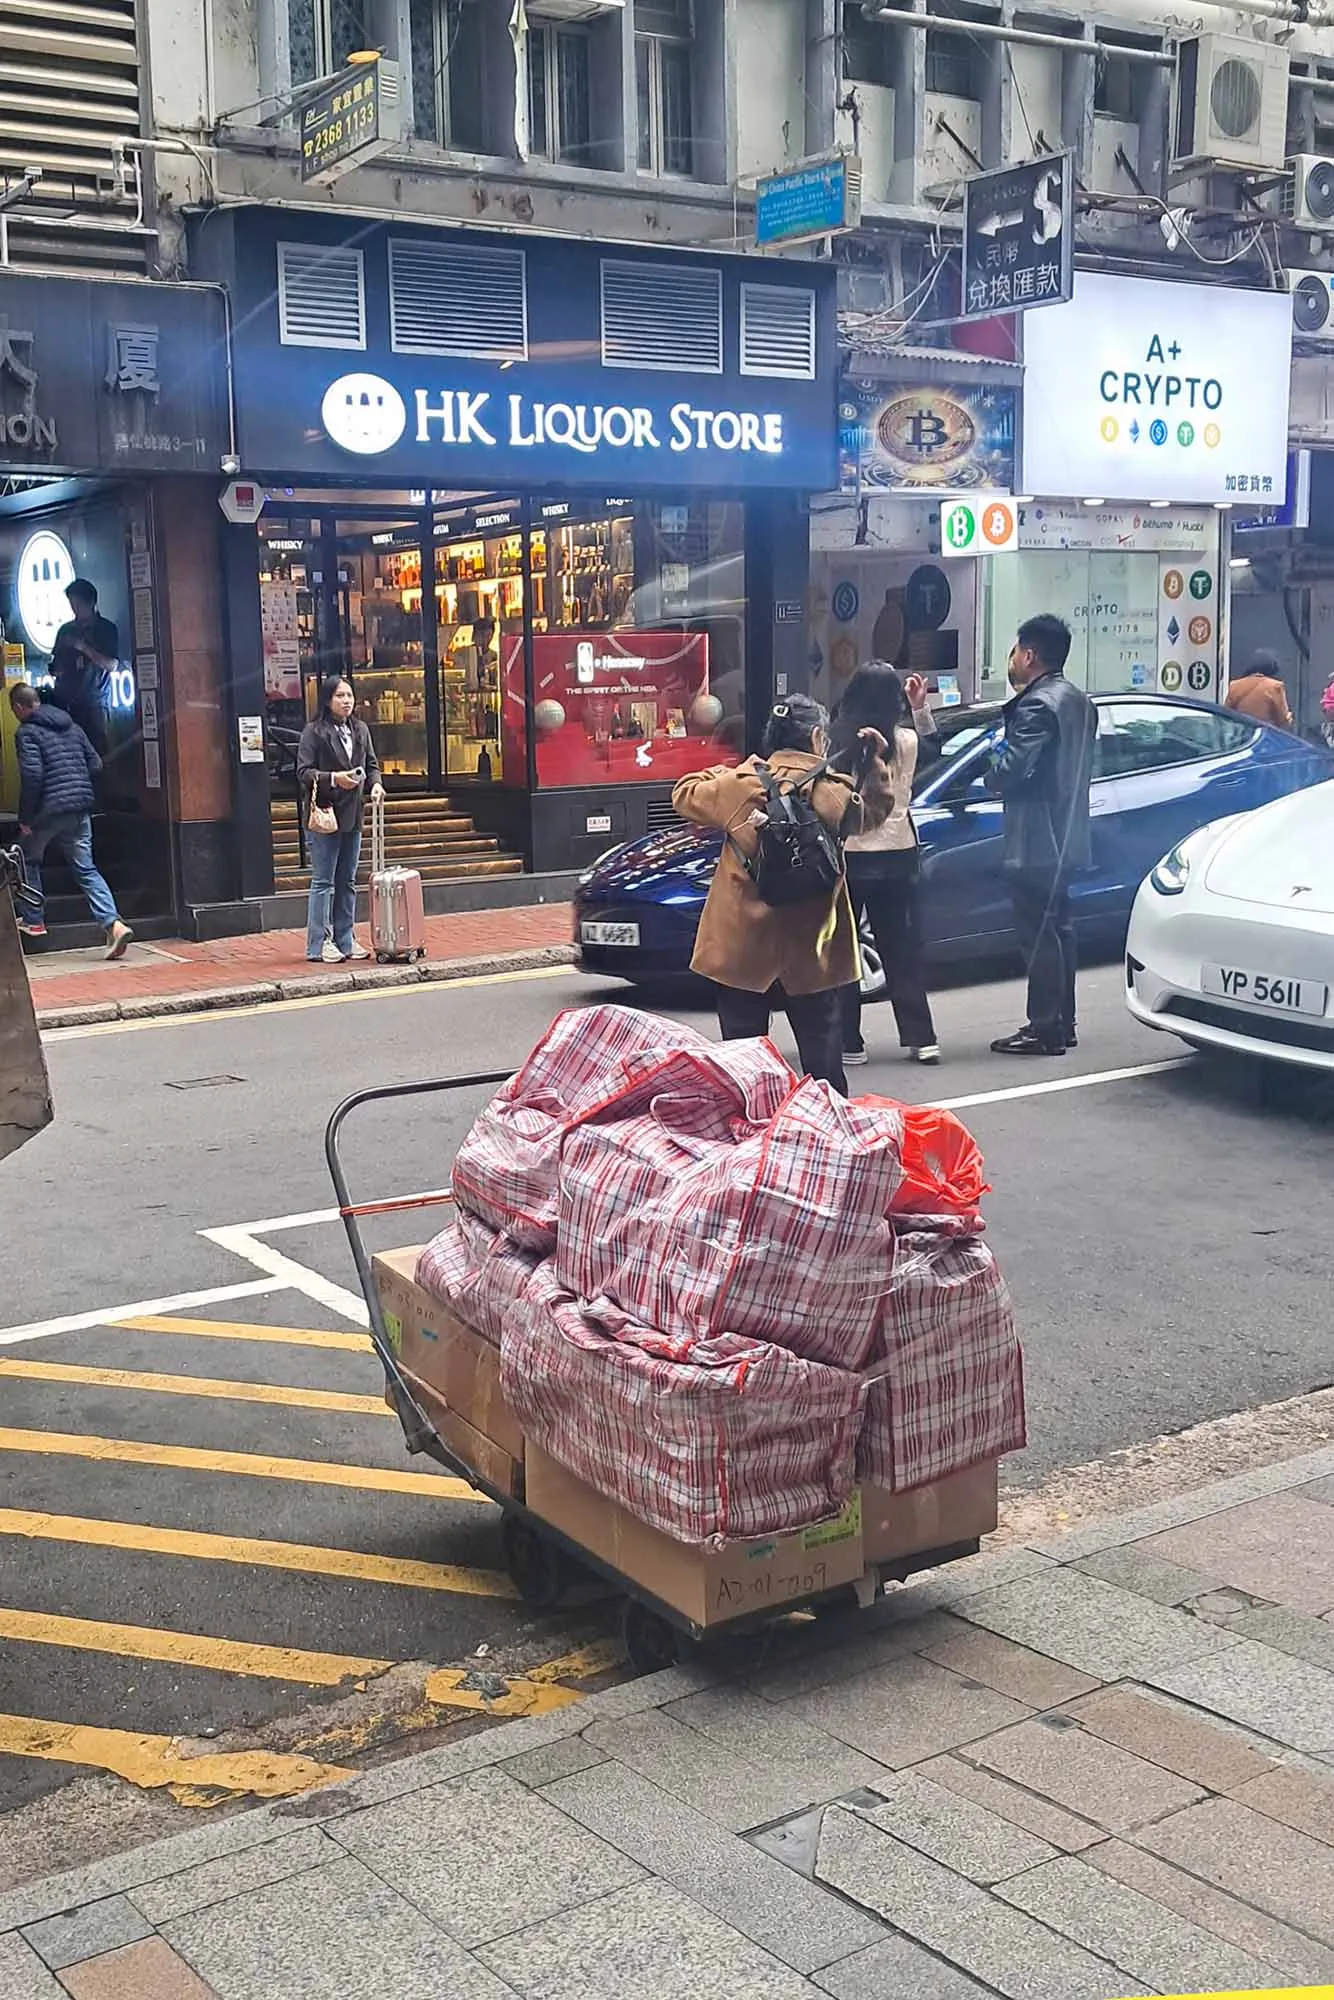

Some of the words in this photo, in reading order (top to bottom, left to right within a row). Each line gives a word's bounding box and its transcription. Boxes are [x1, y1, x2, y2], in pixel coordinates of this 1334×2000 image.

[315, 120, 342, 152] 2368
[345, 102, 374, 133] 1133
[1146, 334, 1182, 364] A+
[1100, 371, 1222, 411] CRYPTO
[415, 390, 496, 444] HK
[475, 512, 511, 528] SELECTION
[267, 539, 304, 551] WHISKY
[1073, 603, 1118, 617] CRPTO
[1220, 967, 1248, 995] YP
[1253, 975, 1301, 1008] 5611
